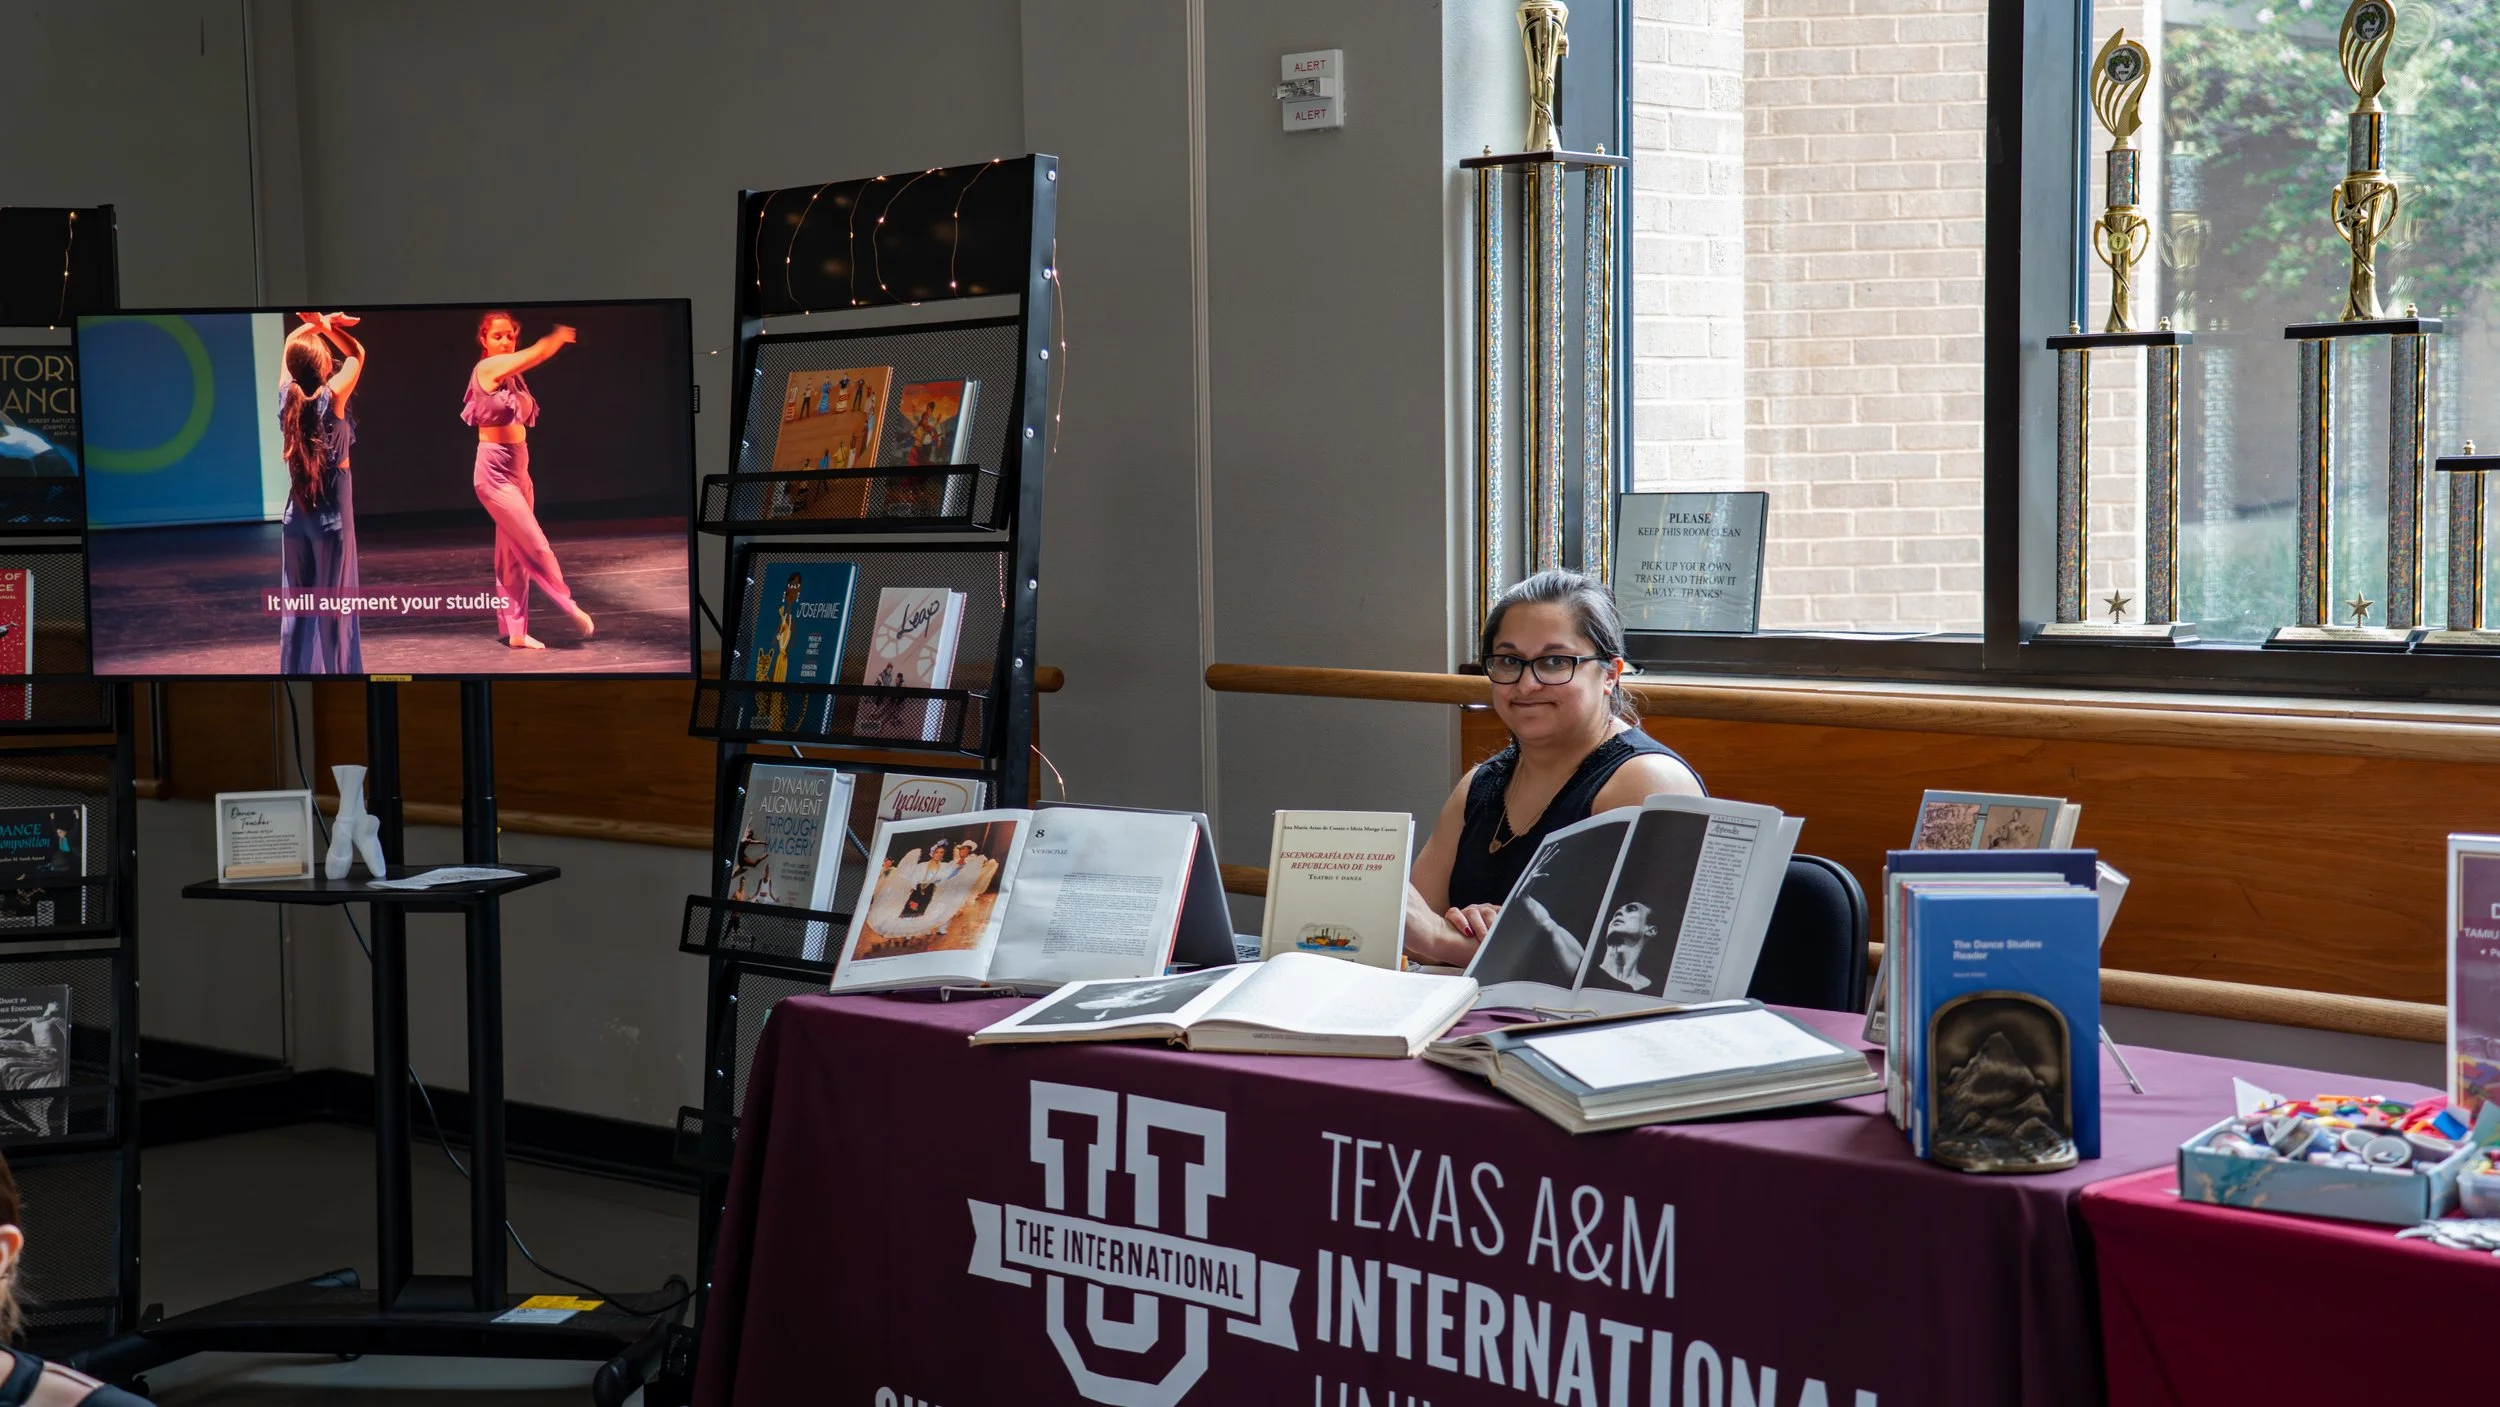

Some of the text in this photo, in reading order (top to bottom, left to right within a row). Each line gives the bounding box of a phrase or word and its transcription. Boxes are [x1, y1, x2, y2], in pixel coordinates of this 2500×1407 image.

[1295, 60, 1326, 72] ALERT
[1295, 109, 1327, 121] ALERT
[1669, 513, 1712, 524] PLEASE
[1638, 527, 1742, 538] KEEP THIS ROOM CLEAN
[1641, 561, 1732, 572] PICK UP YOUR OWN
[1635, 574, 1738, 586] TRASH AND THROW IT
[1681, 588, 1724, 599] THANKS!
[267, 593, 510, 615] It will augment your studies
[796, 602, 841, 619] JOSEPHINE
[896, 600, 940, 639] Leap
[772, 776, 826, 797] DYNAMIC
[759, 795, 824, 816] ALIGNMENT
[892, 789, 946, 814] Inclusive
[240, 813, 273, 830] Teacher
[764, 815, 818, 838] THROUGH
[1035, 829, 1045, 838] 8
[763, 835, 816, 856] IMAGERY
[1280, 851, 1342, 860] ESCENOGRAFÍA
[1343, 852, 1355, 860] EN
[1367, 853, 1396, 861] EXILIO
[1291, 862, 1383, 871] REPUBLICANO DE 1939
[1953, 940, 2043, 949] The Dance Studies
[1953, 951, 1988, 960] Reader
[1321, 1131, 1676, 1299] TEXAS A&M
[1015, 1218, 1244, 1300] THE INTERNATIONAL
